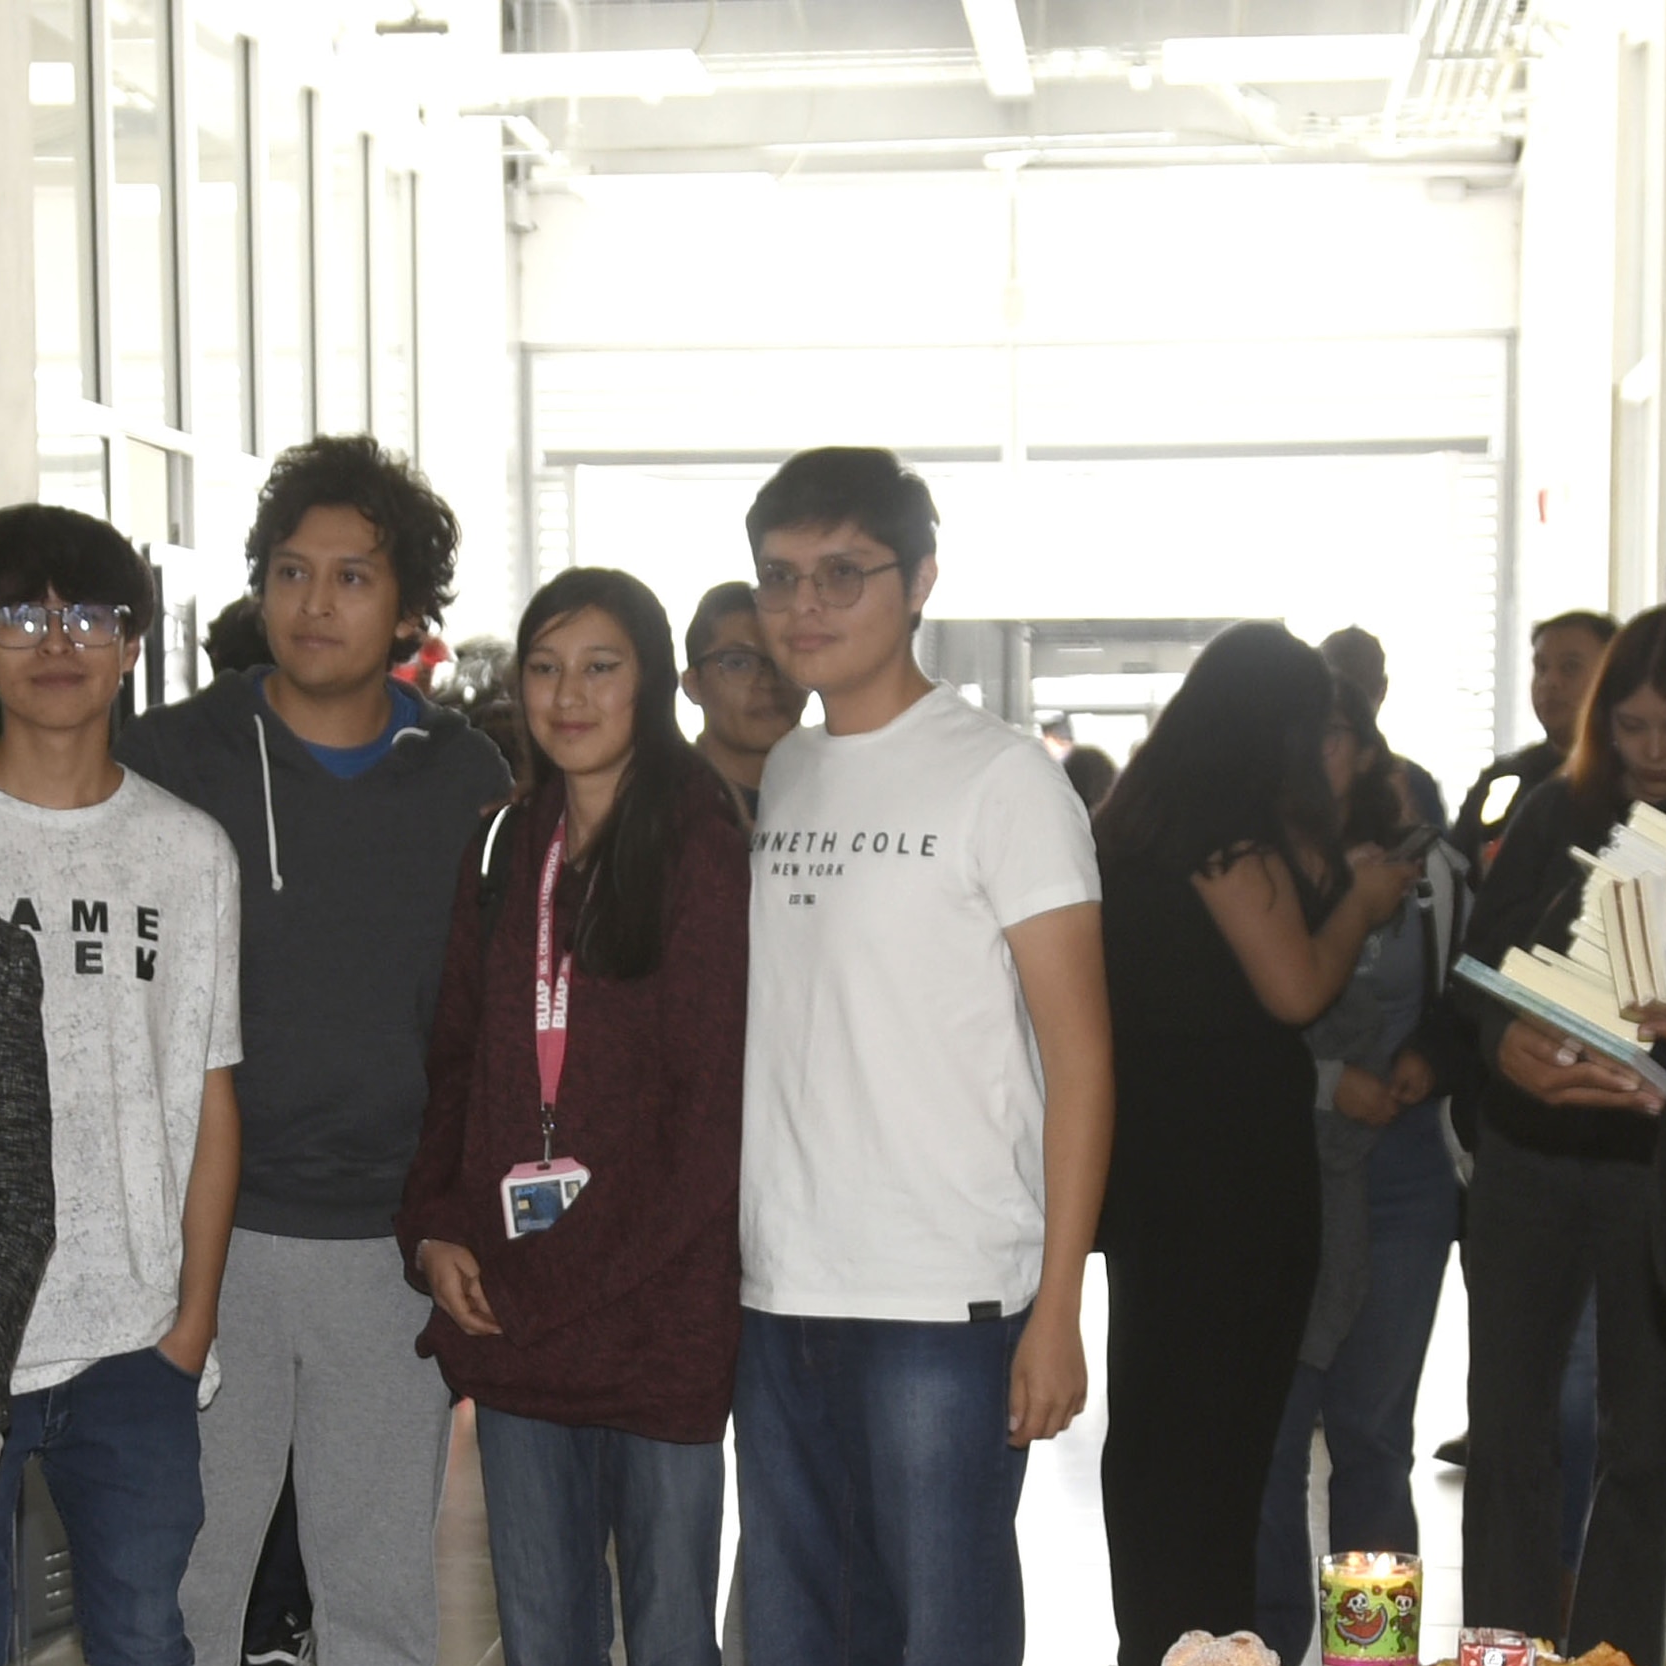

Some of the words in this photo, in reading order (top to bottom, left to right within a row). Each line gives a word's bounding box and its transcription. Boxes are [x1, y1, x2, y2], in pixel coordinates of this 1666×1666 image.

[851, 831, 938, 857] COLE
[771, 862, 800, 877] NEW
[807, 863, 845, 877] YORK
[10, 897, 160, 942] AME
[539, 917, 550, 956] CIENCIAS
[536, 979, 551, 1031] BUAP
[552, 976, 569, 1029] BUAP
